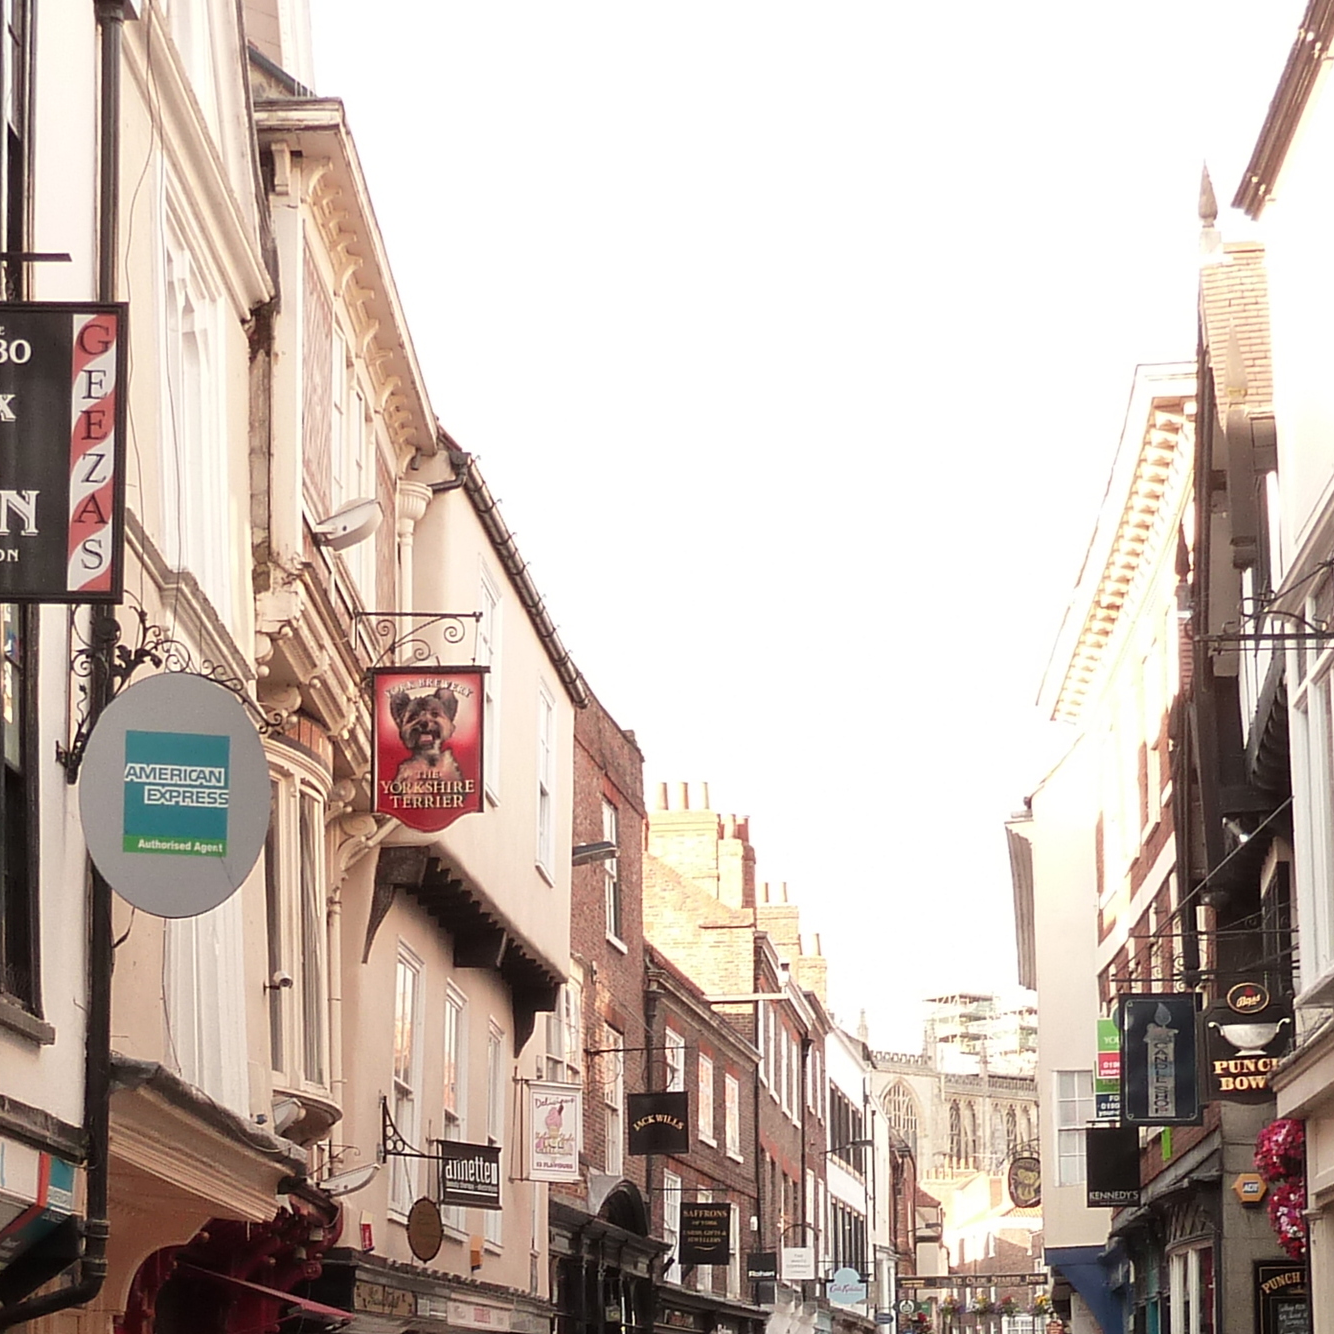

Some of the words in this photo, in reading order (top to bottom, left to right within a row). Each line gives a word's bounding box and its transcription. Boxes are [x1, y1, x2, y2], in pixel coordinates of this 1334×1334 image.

[73, 324, 110, 571] GEEZAS
[124, 763, 225, 787] AMERICAN
[380, 779, 475, 794] YORKSHIRE
[144, 786, 229, 808] EXPRESS
[389, 795, 464, 808] TERRIER
[138, 839, 191, 850] Authorised
[194, 842, 223, 853] Agent
[632, 1114, 655, 1132] JACK
[655, 1113, 685, 1131] WILLS
[1088, 1190, 1139, 1200] KENNEDY'S
[683, 1210, 728, 1218] SAFFRONS
[1261, 1271, 1301, 1294] PUNCH
